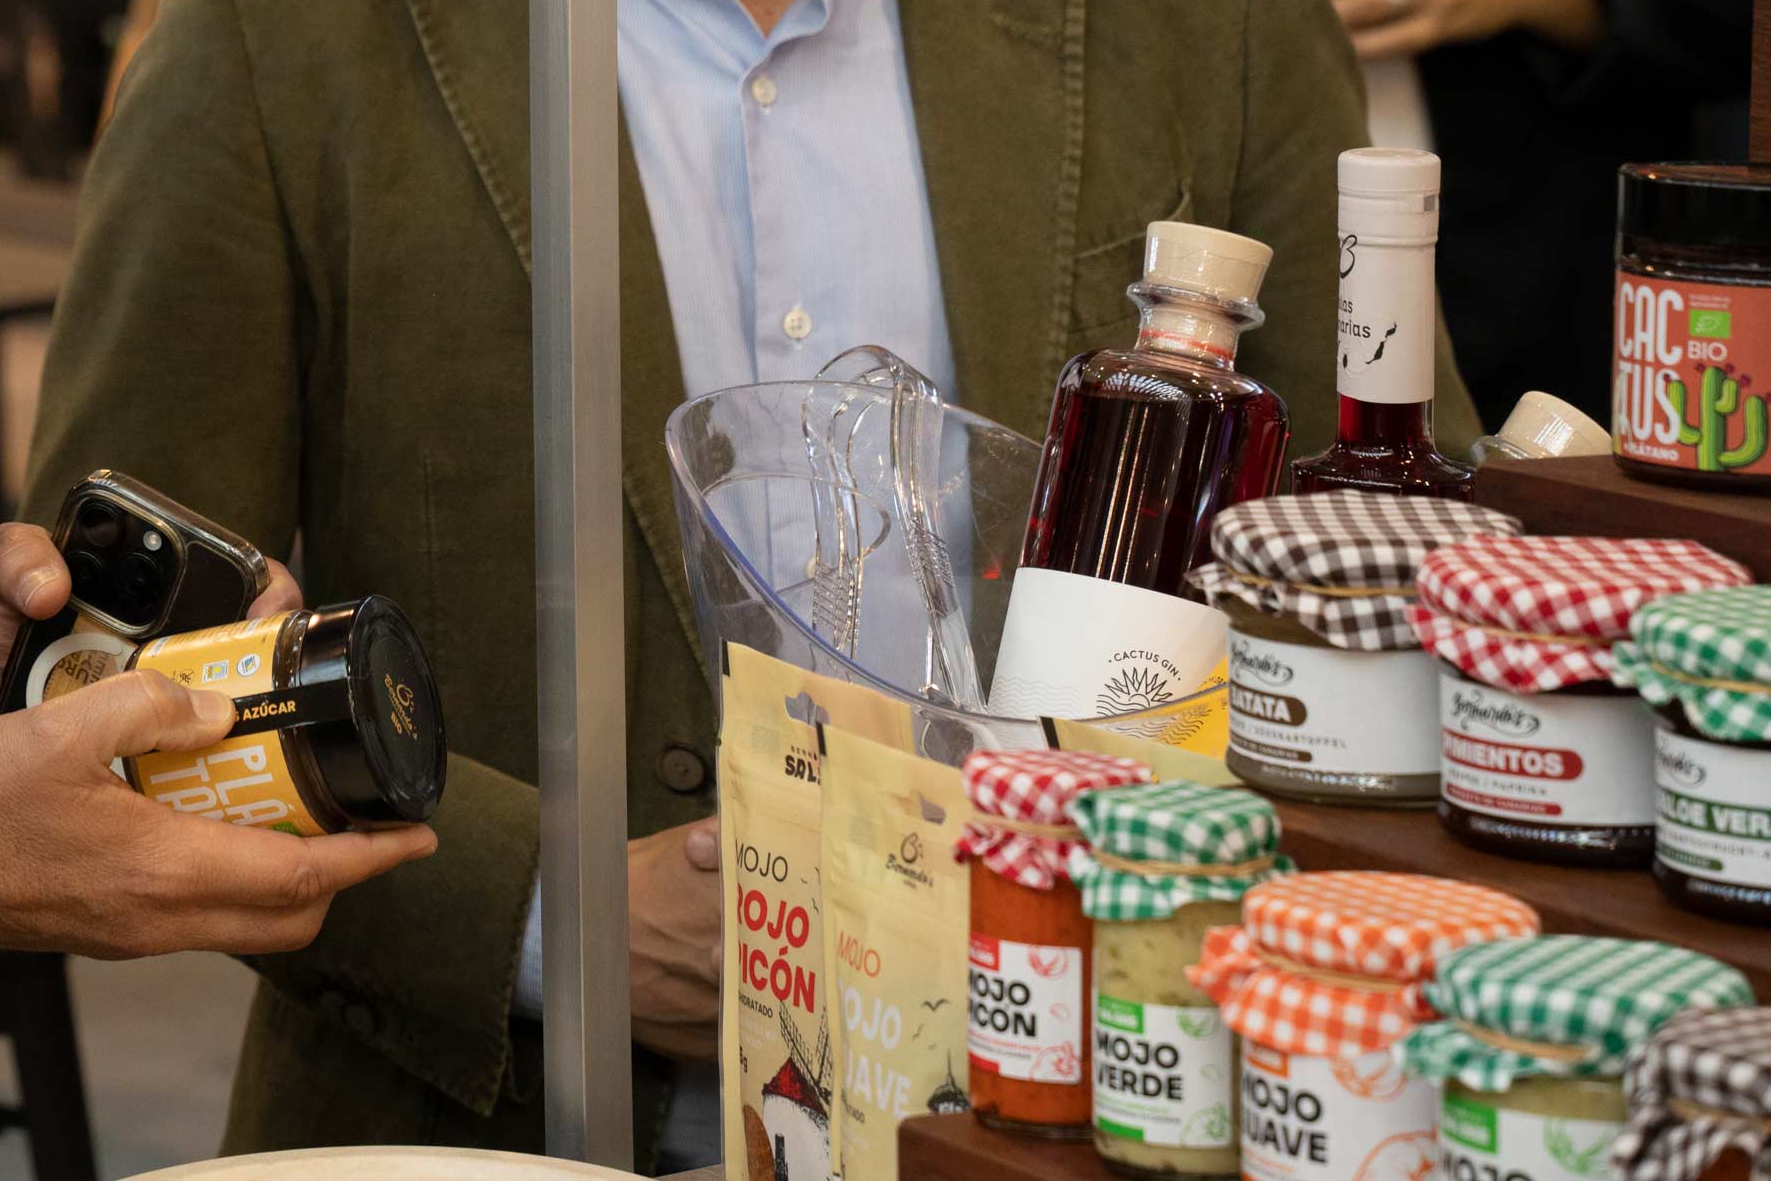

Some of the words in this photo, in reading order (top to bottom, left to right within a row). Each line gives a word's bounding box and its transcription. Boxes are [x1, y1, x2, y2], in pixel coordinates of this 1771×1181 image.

[1618, 281, 1684, 366] CAC
[1687, 339, 1728, 362] BIO
[1113, 649, 1161, 663] CACTUS
[1161, 658, 1180, 678] GIN
[242, 699, 297, 722] AZÚCAR
[149, 757, 226, 820] TA
[784, 754, 821, 786] SAL
[1711, 804, 1771, 839] VER
[735, 838, 788, 883] MOJO
[837, 930, 881, 979] MOJO
[737, 939, 816, 1014] ICÓN
[837, 978, 902, 1051] OJO
[1096, 1029, 1179, 1069] MOJO
[1097, 1064, 1184, 1101] VERDE
[1243, 1109, 1328, 1164] UAVE
